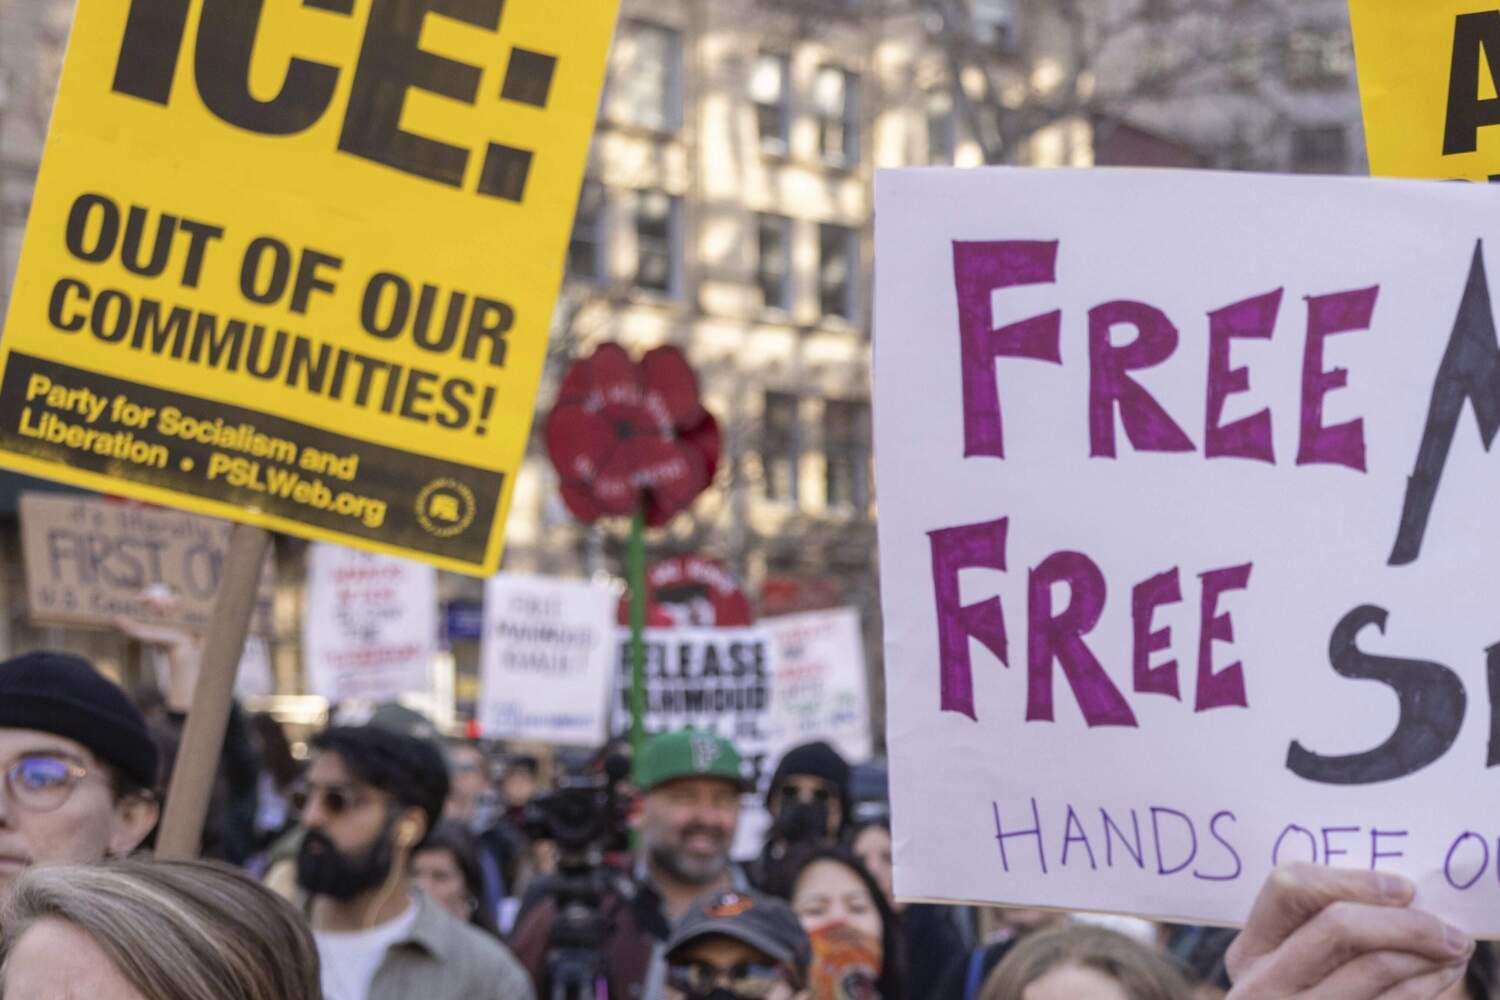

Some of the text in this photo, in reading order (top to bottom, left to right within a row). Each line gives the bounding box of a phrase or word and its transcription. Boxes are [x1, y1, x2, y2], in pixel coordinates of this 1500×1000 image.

[111, 0, 559, 205] ICE:
[47, 277, 498, 437] COMMUNITIES!
[64, 192, 517, 368] OUT OF OUR
[951, 238, 1381, 474] FREE
[18, 407, 170, 469] Liberation
[206, 453, 388, 528] PSLWeb.org
[25, 373, 360, 482] Party for Socialism and
[924, 515, 1255, 729] FREE
[993, 798, 1243, 881] HANDS
